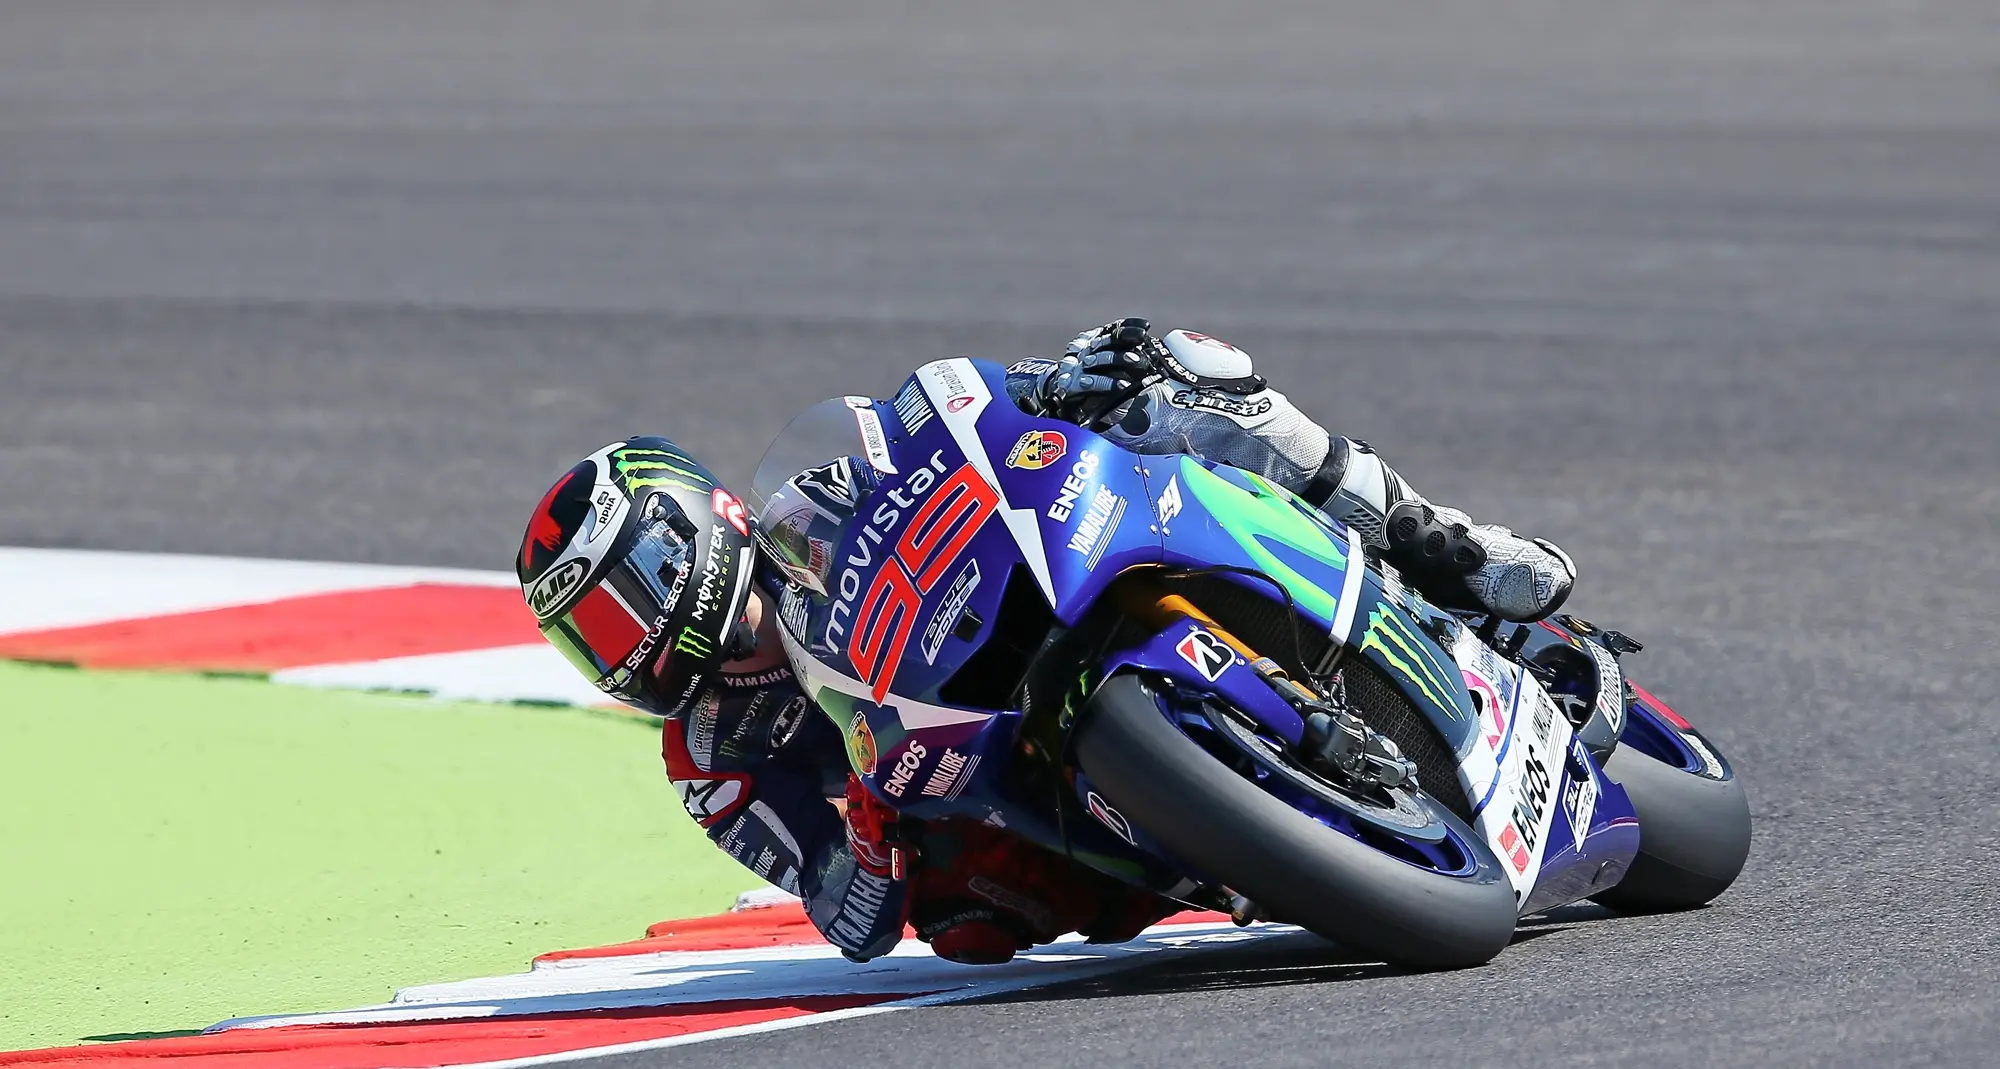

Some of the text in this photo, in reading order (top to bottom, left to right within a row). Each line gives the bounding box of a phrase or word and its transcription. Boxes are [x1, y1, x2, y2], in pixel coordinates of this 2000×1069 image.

[1165, 356, 1198, 384] AHEAD
[893, 380, 934, 437] YAMAHA
[599, 497, 616, 524] RPHA
[1047, 450, 1100, 523] ENEOS
[1067, 484, 1118, 557] YAMALUBE
[692, 523, 726, 621] MONSTER
[712, 543, 732, 611] ENERGY
[825, 449, 948, 655] movistar
[533, 561, 576, 612] HJC
[664, 560, 693, 612] SECTOR
[848, 461, 1001, 708] 99
[928, 573, 967, 639] BLUE
[626, 615, 669, 670] SECTOR
[594, 676, 618, 692] TOR
[682, 673, 702, 698] Bank
[724, 668, 793, 688] YAMAHA
[732, 689, 769, 741] MONSTER
[884, 740, 927, 797] ENEOS
[921, 748, 968, 797] YAMALUBE
[1512, 744, 1550, 853] ENEOS
[826, 867, 891, 953] YAMAHA
